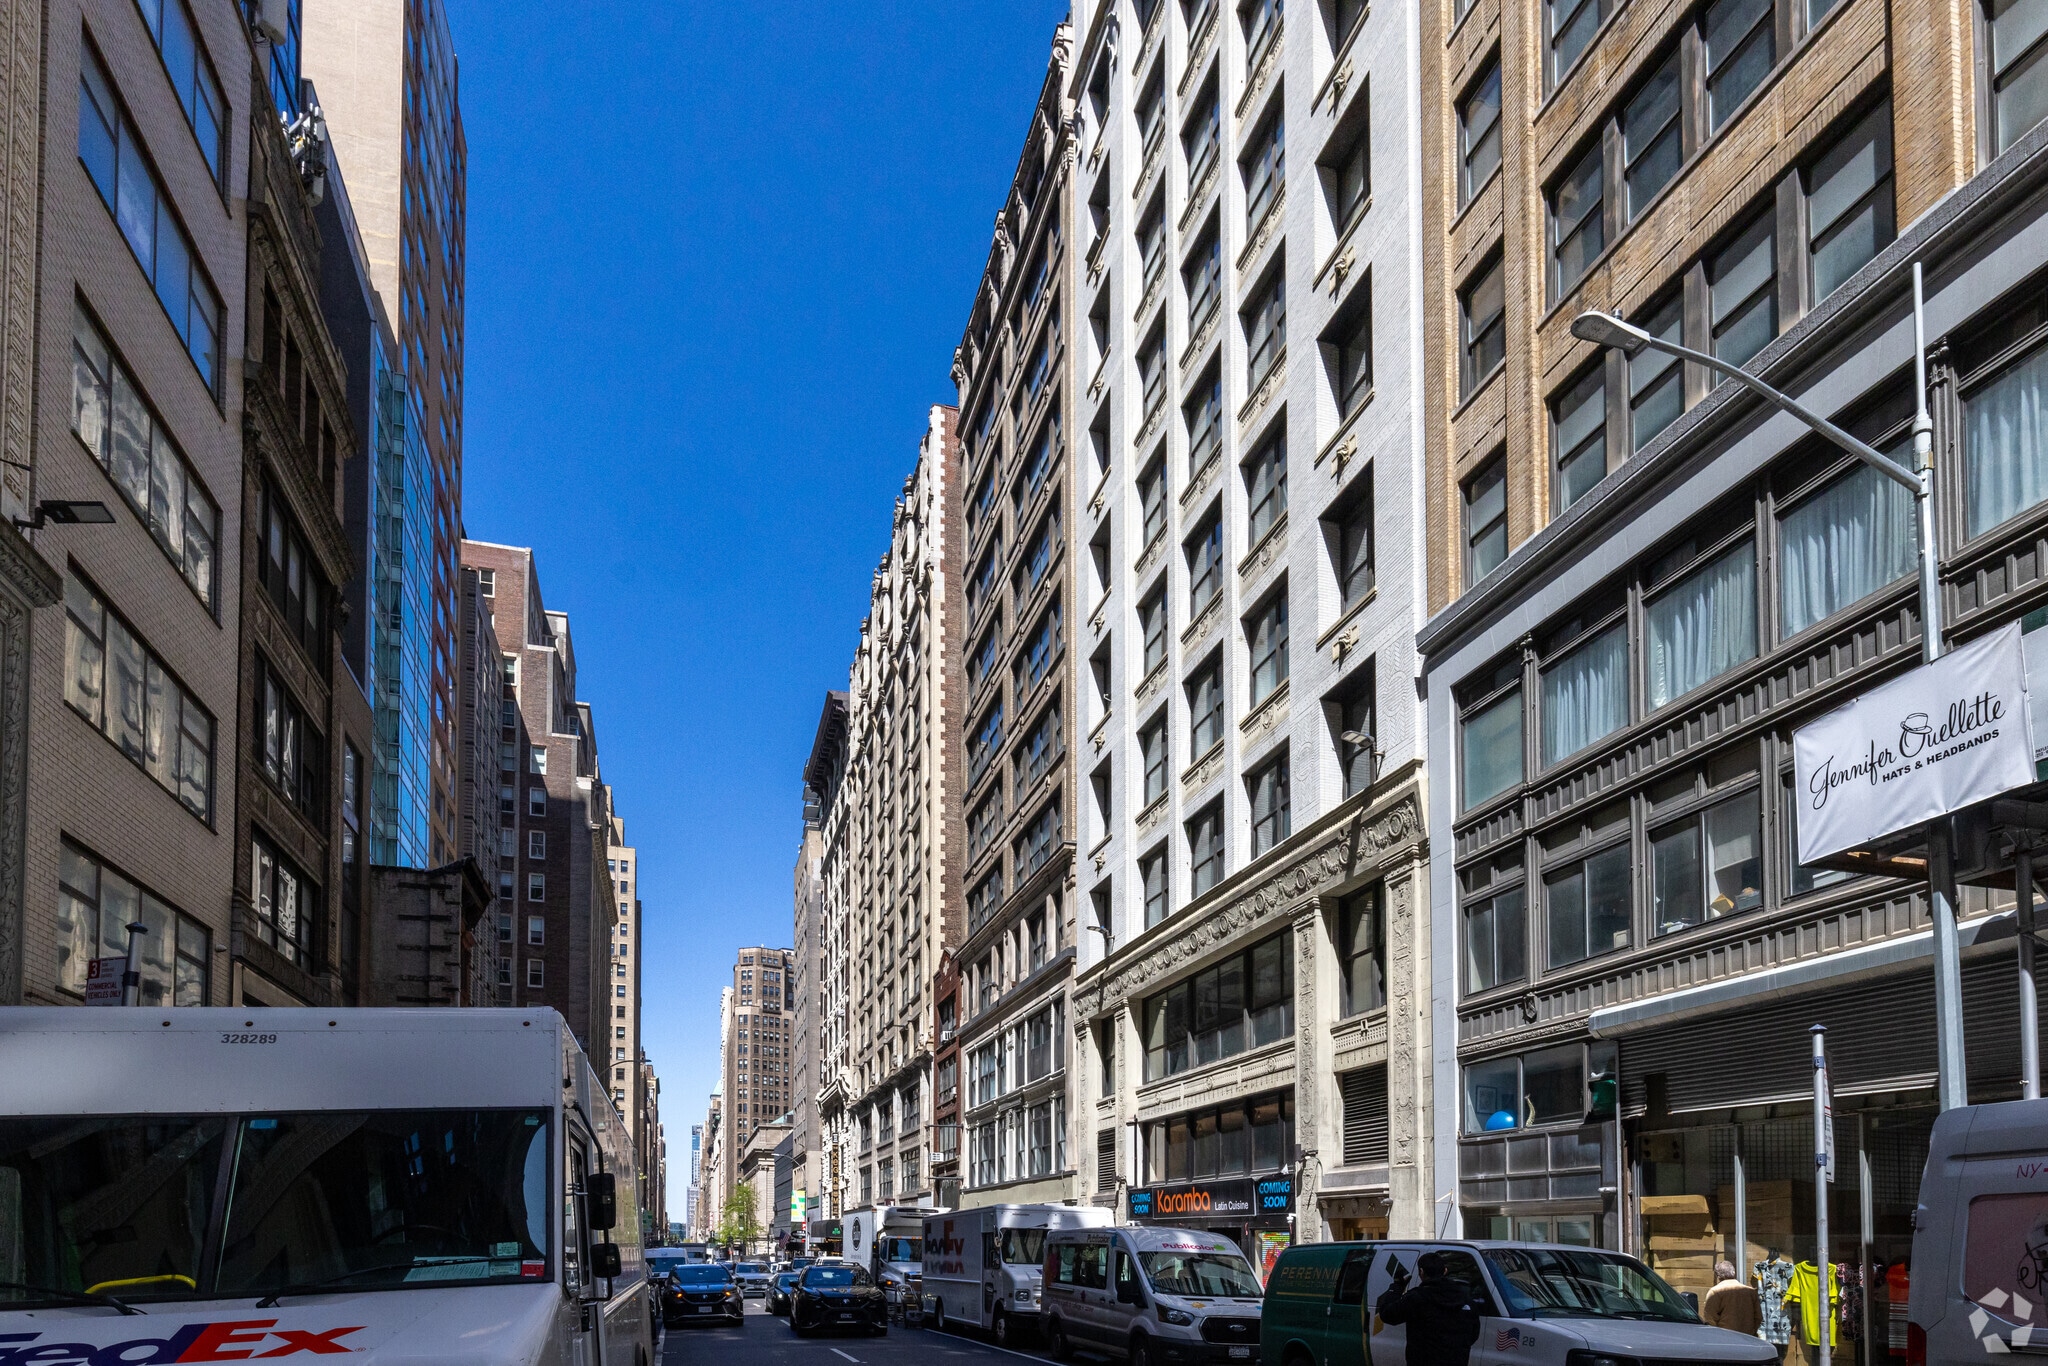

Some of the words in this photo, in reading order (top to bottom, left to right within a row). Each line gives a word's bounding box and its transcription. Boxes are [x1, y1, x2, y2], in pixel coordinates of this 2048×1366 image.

[1809, 739, 1897, 810] Jennifer
[1899, 691, 2006, 758] Ouellette
[1882, 765, 1912, 783] HATS
[1914, 760, 1923, 770] &
[1927, 728, 2000, 766] HEADBANDS
[90, 962, 98, 977] 3
[89, 981, 118, 991] COMMERCIAL
[88, 991, 109, 999] VEHICLES
[110, 990, 121, 998] ONLY
[221, 1034, 277, 1044] 328289
[1258, 1180, 1291, 1194] COMING
[1131, 1192, 1151, 1204] COMING
[1157, 1186, 1211, 1213] Karamba
[1263, 1195, 1287, 1209] SOON
[1134, 1204, 1149, 1214] SOON
[1214, 1201, 1228, 1211] Latin
[1228, 1200, 1249, 1210] Cuisine
[1161, 1242, 1215, 1251] Publicolor
[1522, 1336, 1536, 1347] 28
